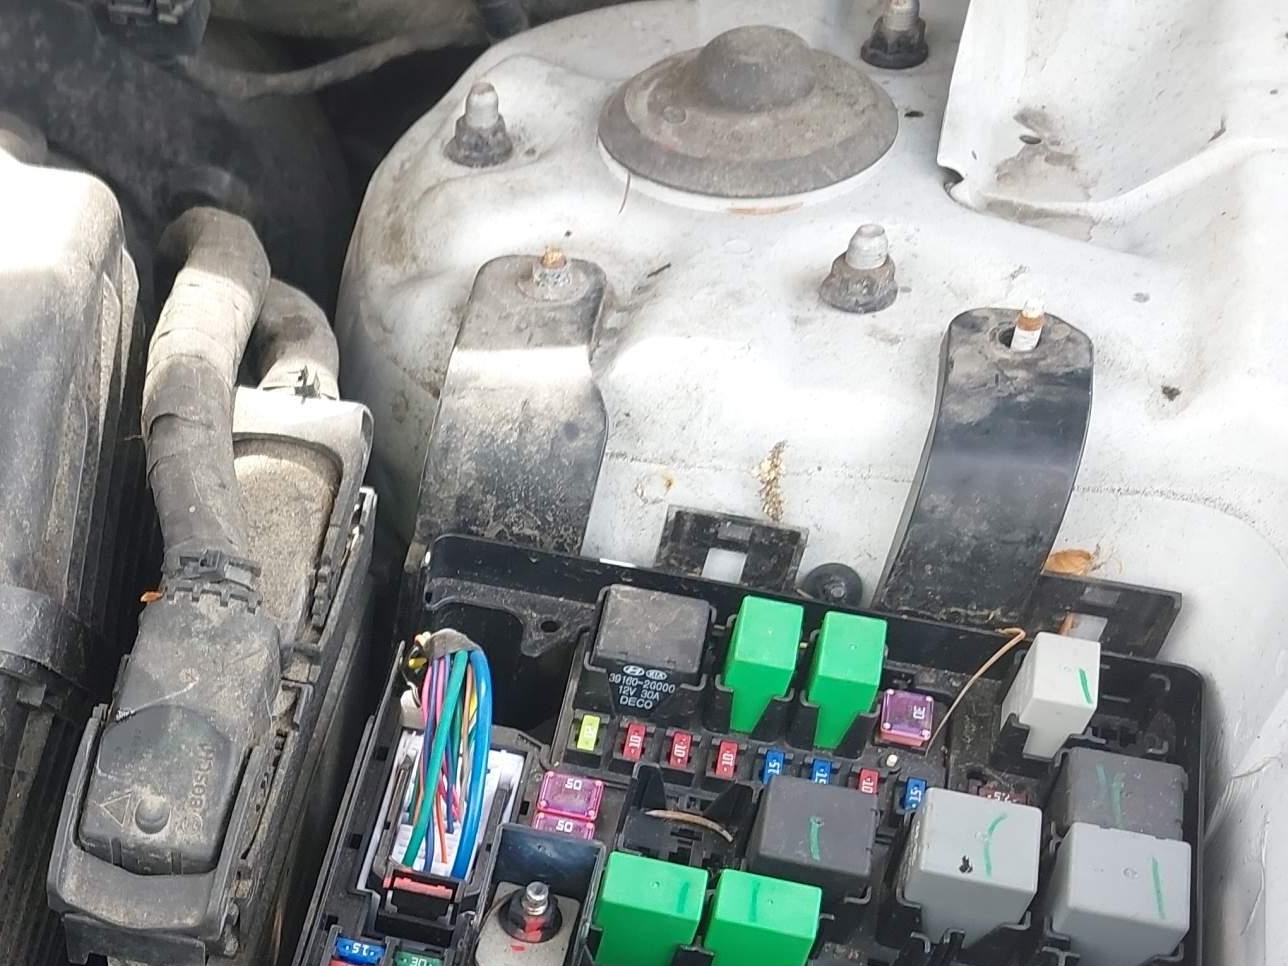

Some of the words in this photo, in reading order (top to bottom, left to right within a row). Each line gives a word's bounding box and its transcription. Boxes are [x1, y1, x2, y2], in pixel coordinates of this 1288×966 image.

[618, 685, 636, 698] 12V
[641, 688, 660, 701] 30A
[620, 695, 653, 711] DECO
[913, 705, 926, 719] 30
[565, 779, 582, 790] 50
[556, 821, 573, 832] 50
[352, 942, 369, 957] 15
